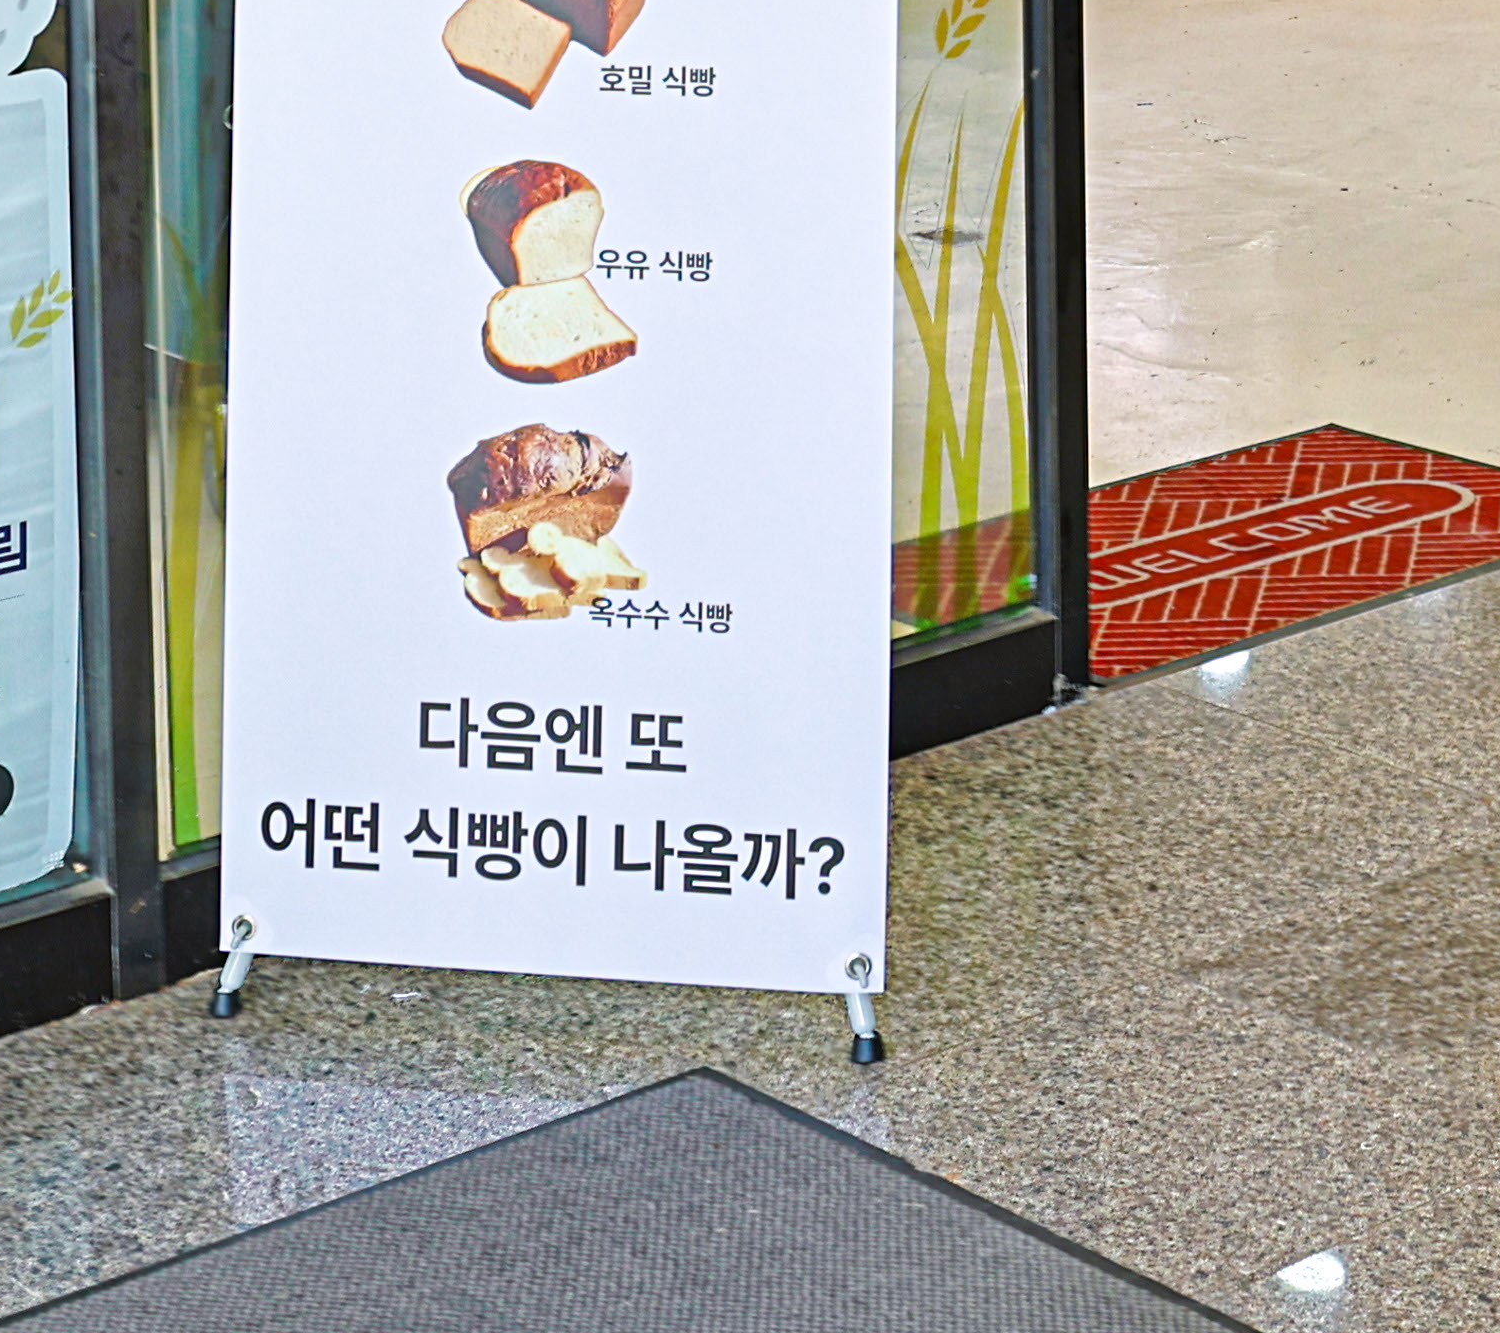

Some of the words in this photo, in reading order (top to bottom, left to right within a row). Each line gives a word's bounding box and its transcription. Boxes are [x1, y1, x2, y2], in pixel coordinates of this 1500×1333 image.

[598, 65, 653, 96] 호밀
[660, 65, 717, 98] 식빵
[595, 249, 650, 280] 우유
[657, 249, 713, 282] 식빵
[587, 597, 670, 631] 옥수수
[677, 601, 733, 634] 식빵
[417, 695, 604, 775] 다음엔
[624, 713, 688, 773] 또
[260, 797, 382, 872] 어떤
[403, 805, 588, 886] 식빵이
[612, 818, 847, 901] 나올까?
